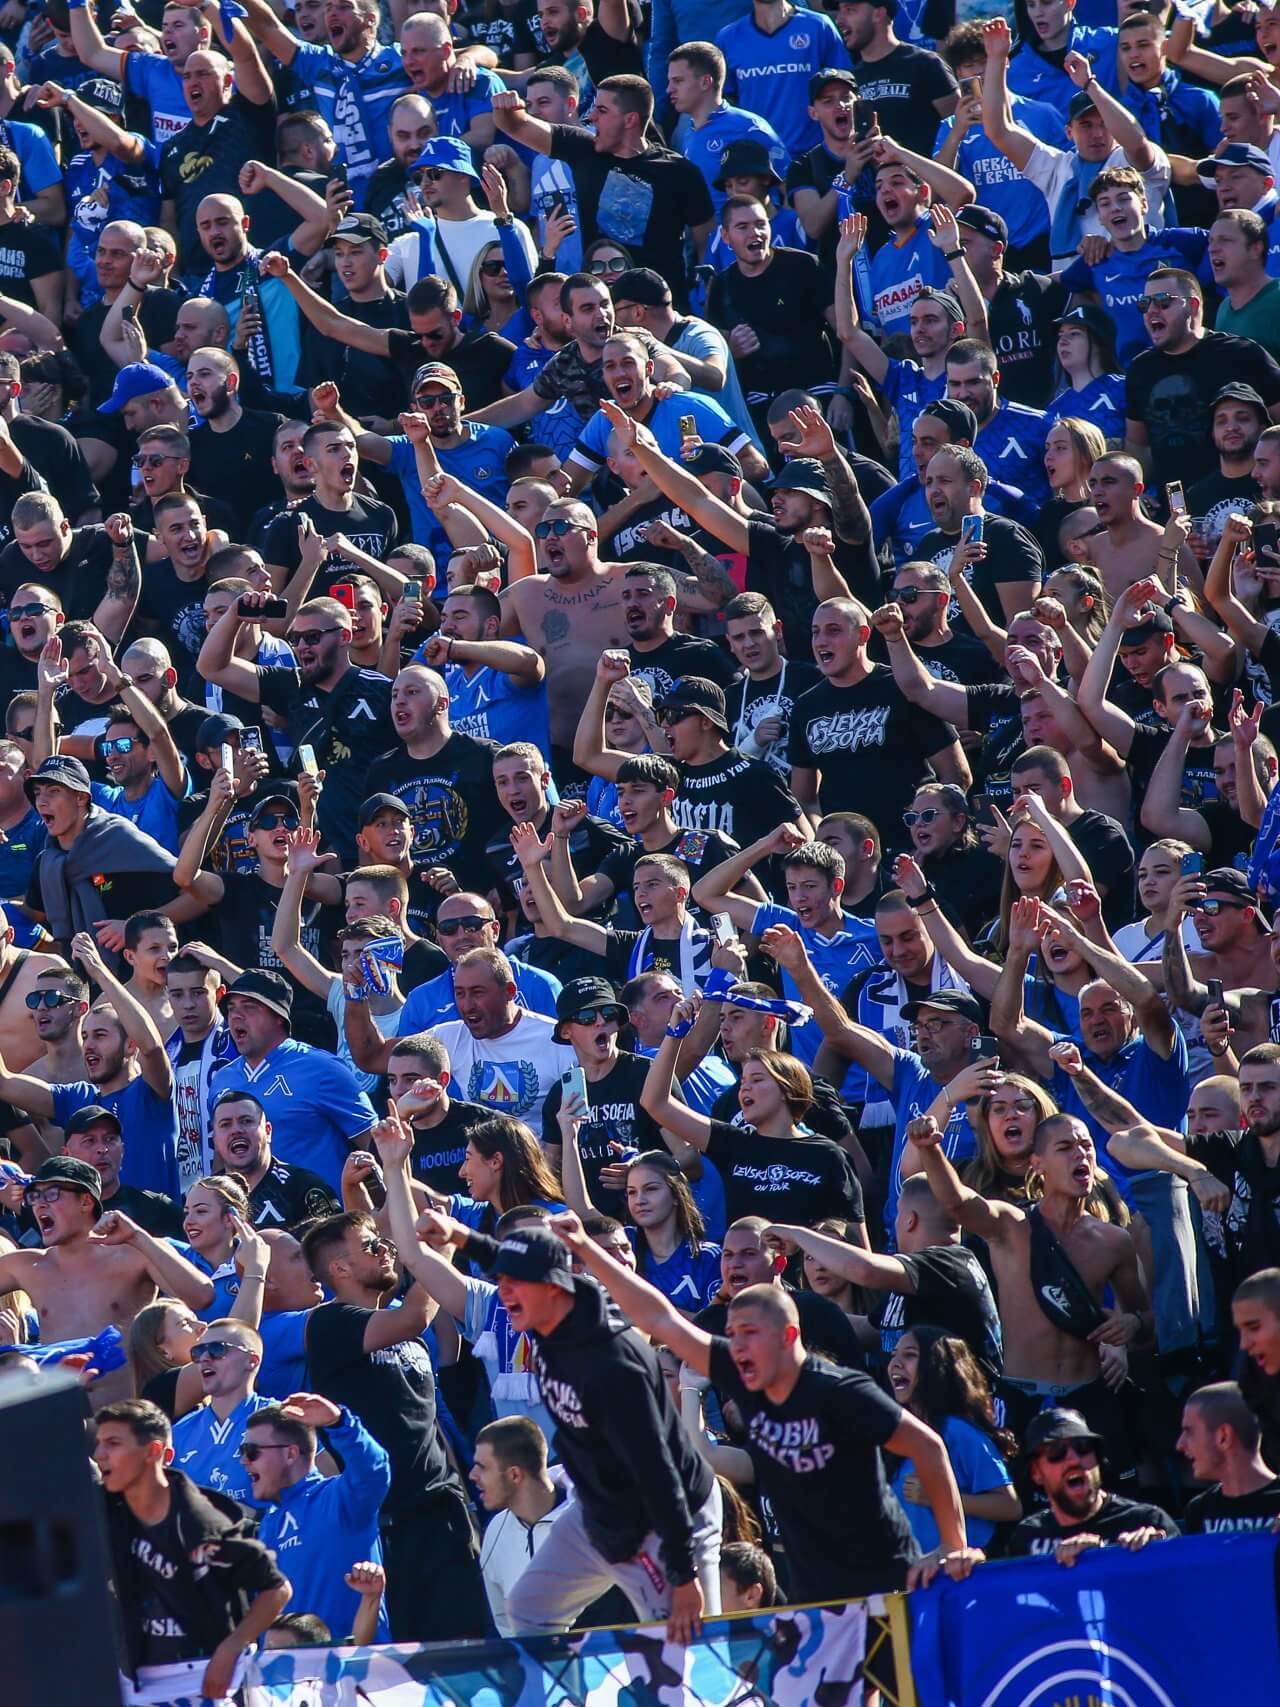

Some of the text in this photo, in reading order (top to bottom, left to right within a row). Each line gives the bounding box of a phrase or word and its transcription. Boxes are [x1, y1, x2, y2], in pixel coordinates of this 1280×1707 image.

[742, 63, 812, 78] VIVACOM
[153, 117, 191, 131] STRA
[543, 576, 614, 605] CRIMINAL
[727, 759, 751, 777] YOU
[603, 1102, 636, 1121] SOFIA
[733, 1164, 823, 1185] LEVSKI SOFIA
[754, 1184, 768, 1192] ON
